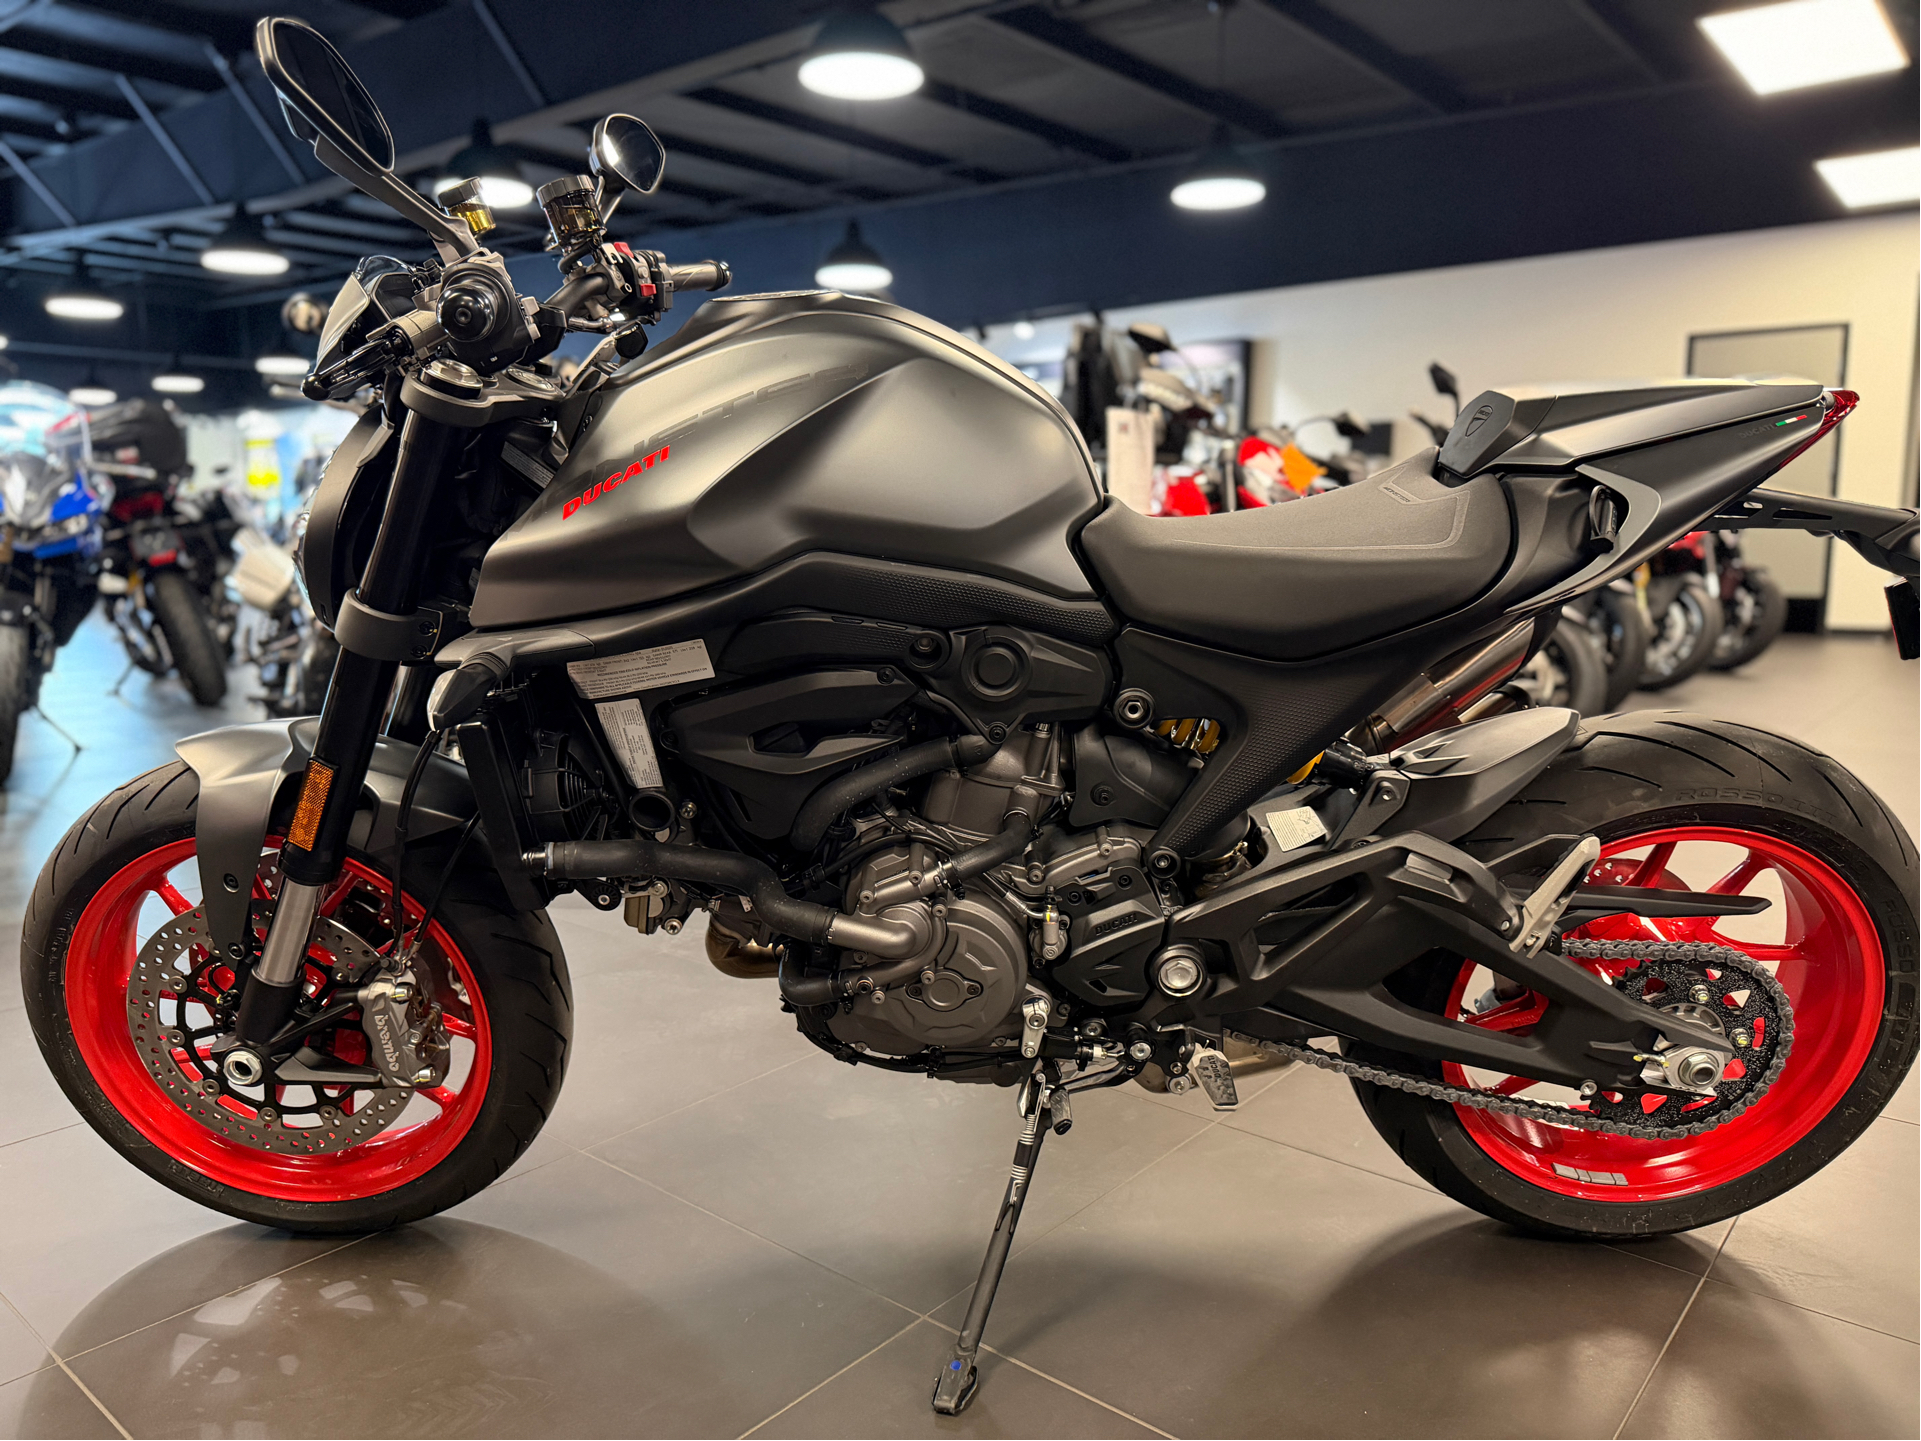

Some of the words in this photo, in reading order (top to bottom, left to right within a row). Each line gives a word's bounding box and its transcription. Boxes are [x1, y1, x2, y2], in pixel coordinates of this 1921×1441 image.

[1738, 423, 1776, 439] DUCATI
[562, 445, 671, 521] DUCATI
[1674, 787, 1785, 805] ROSSO
[1095, 914, 1138, 936] DUCATI
[374, 1014, 401, 1072] brembo
[1207, 1054, 1222, 1079] DUCATI
